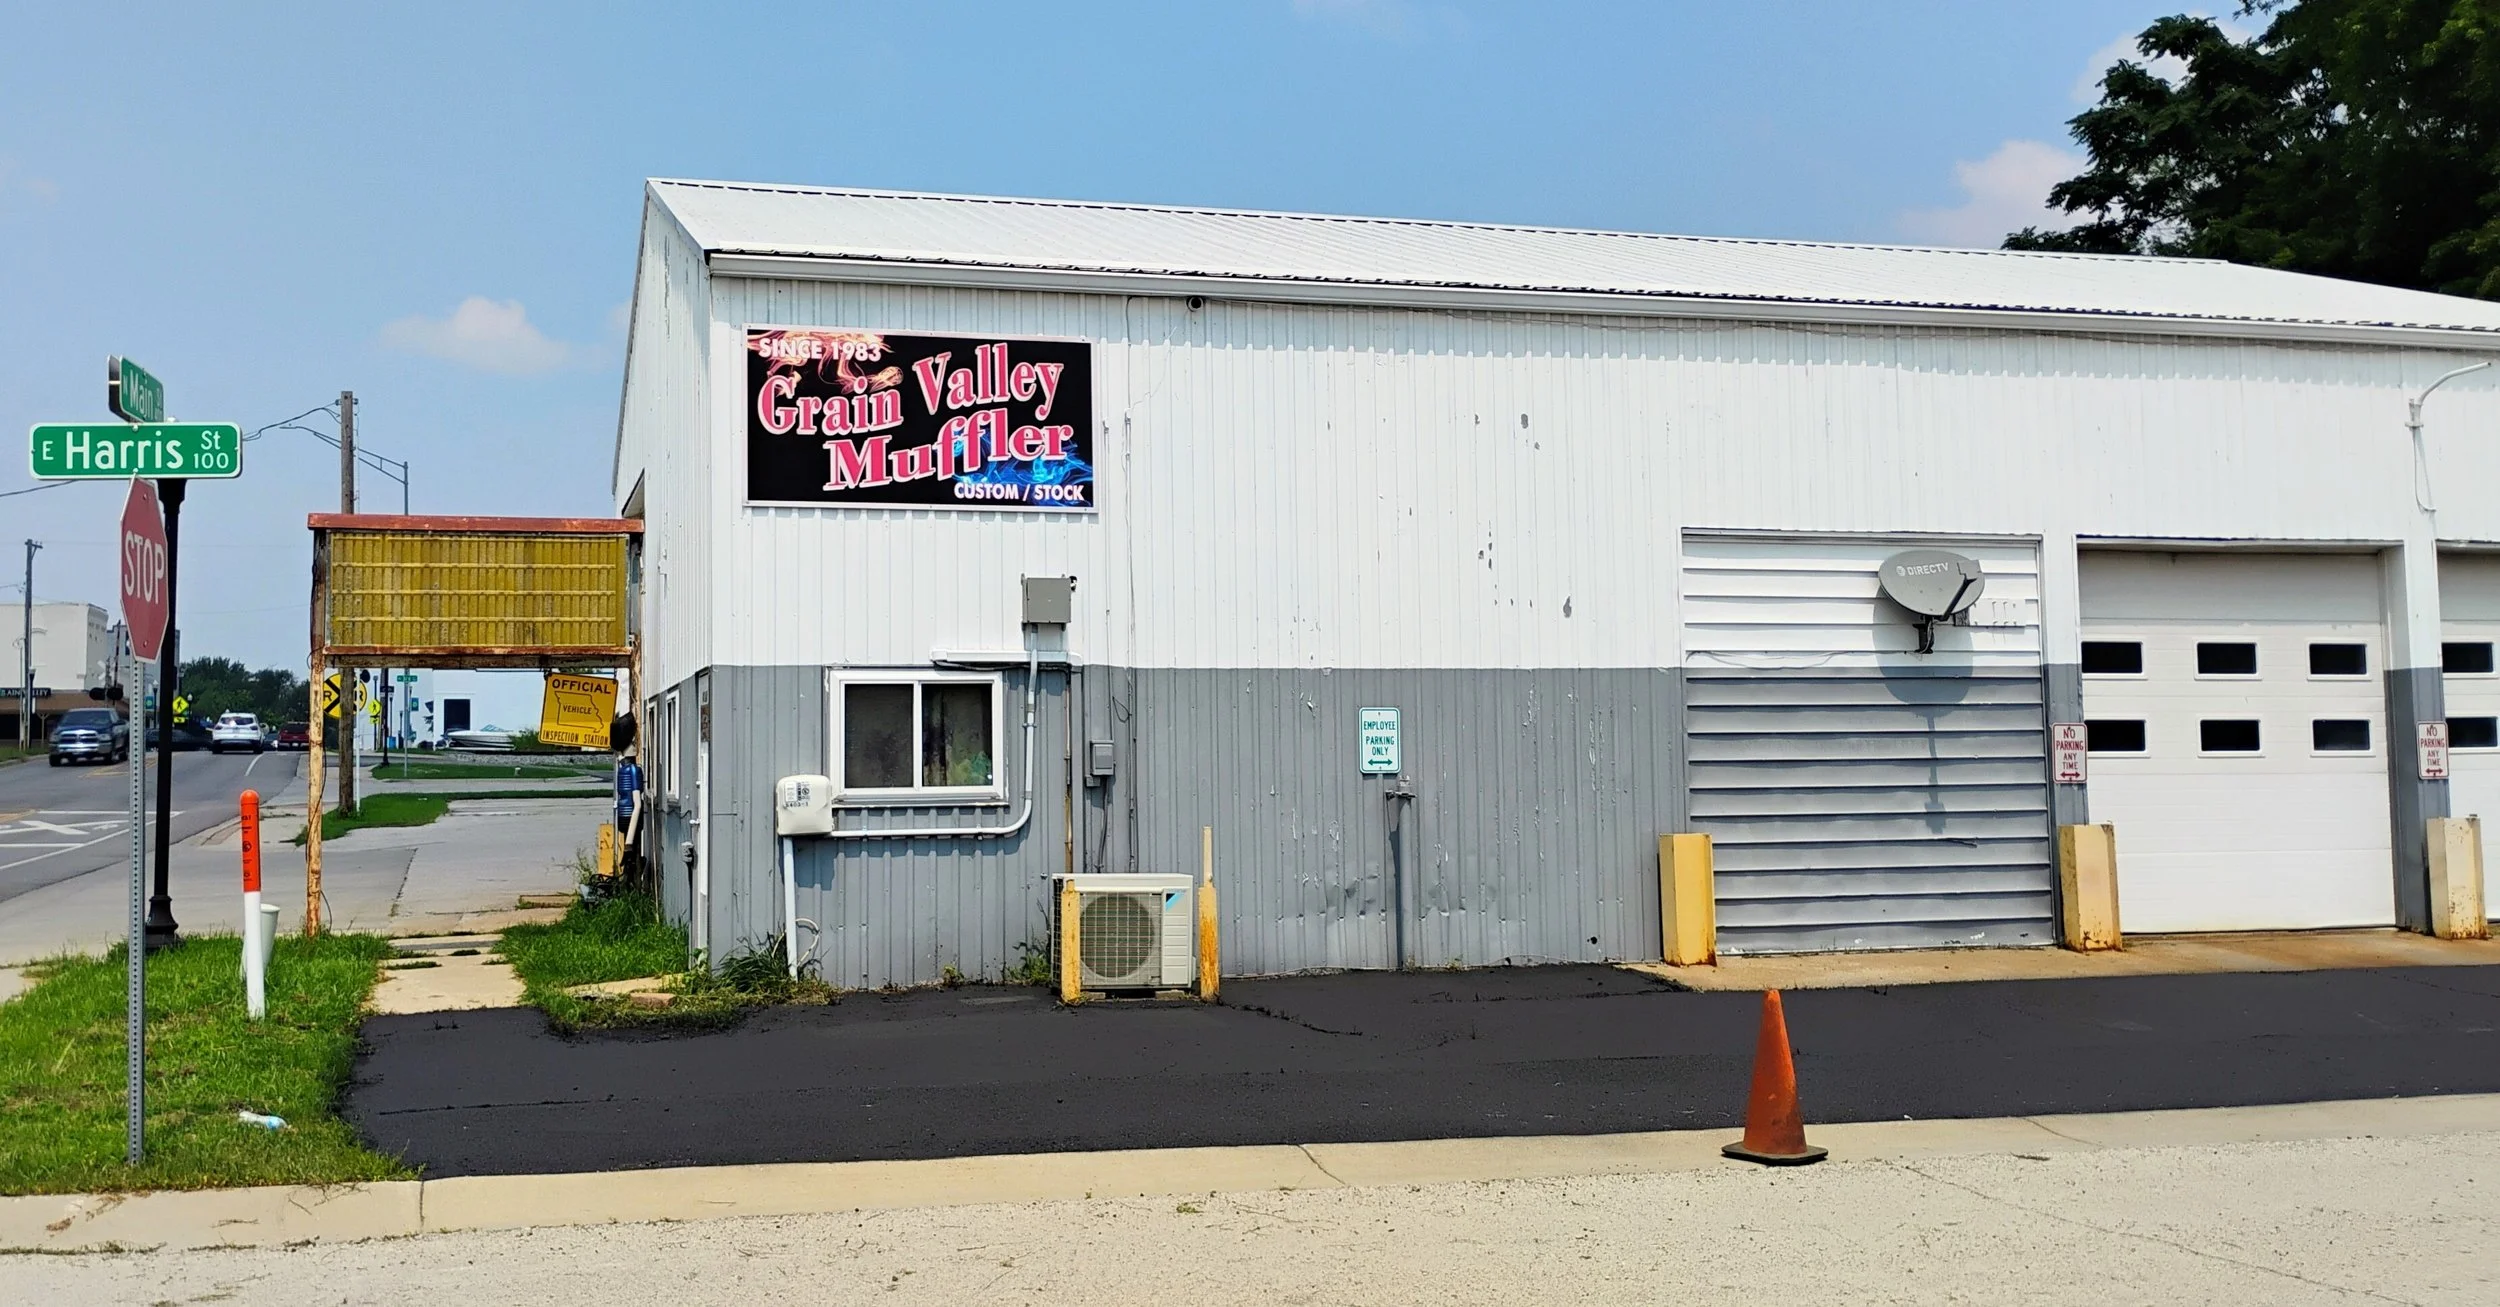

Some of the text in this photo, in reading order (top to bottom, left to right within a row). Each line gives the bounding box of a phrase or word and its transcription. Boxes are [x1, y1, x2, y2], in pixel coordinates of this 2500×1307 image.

[758, 337, 882, 362] SINCE 1983
[757, 342, 1065, 435] Grain Valley
[130, 369, 154, 421] Main
[42, 430, 221, 470] E Harris St
[823, 408, 1075, 491] Muffler
[193, 452, 229, 469] 100
[954, 482, 1019, 500] CUSTOM
[1035, 484, 1085, 501] STOCK
[124, 529, 165, 605] STOP
[1906, 562, 1949, 576] DIRECTV
[552, 679, 612, 695] OFFICIAL
[323, 690, 332, 701] R
[563, 705, 593, 715] VEHICLE
[1363, 720, 1396, 731] EMPLOYEE
[2426, 726, 2438, 737] NO
[543, 730, 609, 746] INSPECTION STATION
[2063, 728, 2076, 739] NO
[1365, 735, 1395, 746] PARKING
[2055, 740, 2084, 751] PARKING
[2420, 738, 2446, 749] PARKING
[1371, 746, 1389, 756] ONLY
[2063, 752, 2077, 761] ANY
[2062, 761, 2079, 770] TIME
